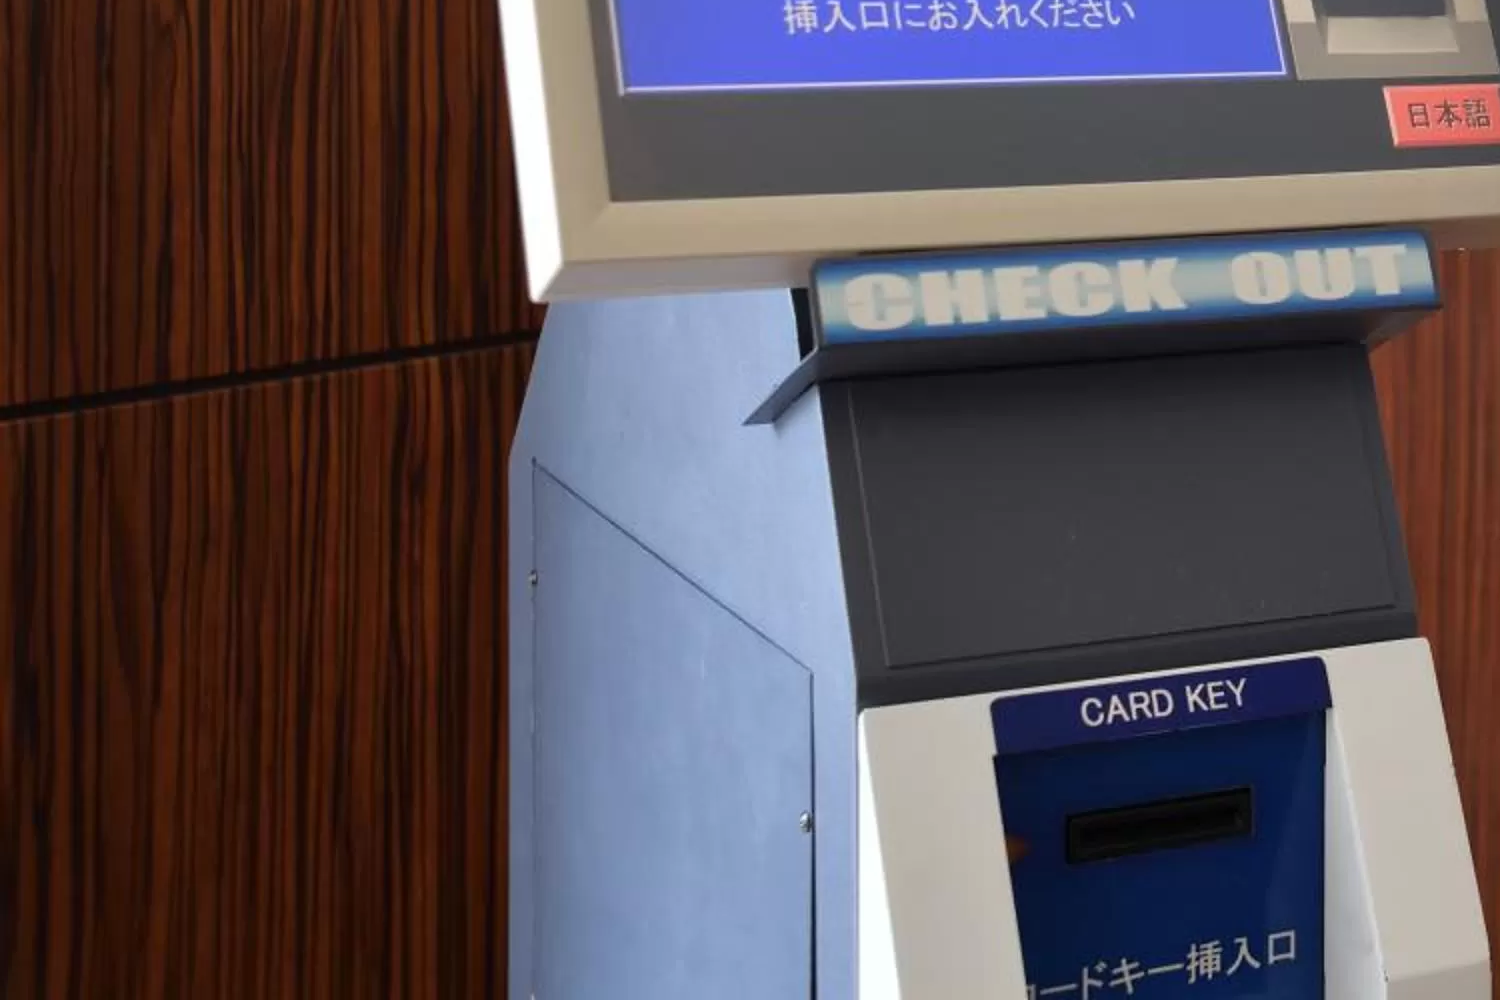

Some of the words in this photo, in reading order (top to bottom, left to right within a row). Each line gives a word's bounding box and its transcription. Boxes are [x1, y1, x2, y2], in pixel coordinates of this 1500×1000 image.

[1407, 97, 1492, 129] 日本語
[843, 256, 1189, 332] CHECK
[1230, 243, 1408, 305] OUT
[1080, 688, 1175, 728] CARD
[1186, 677, 1248, 714] KEY
